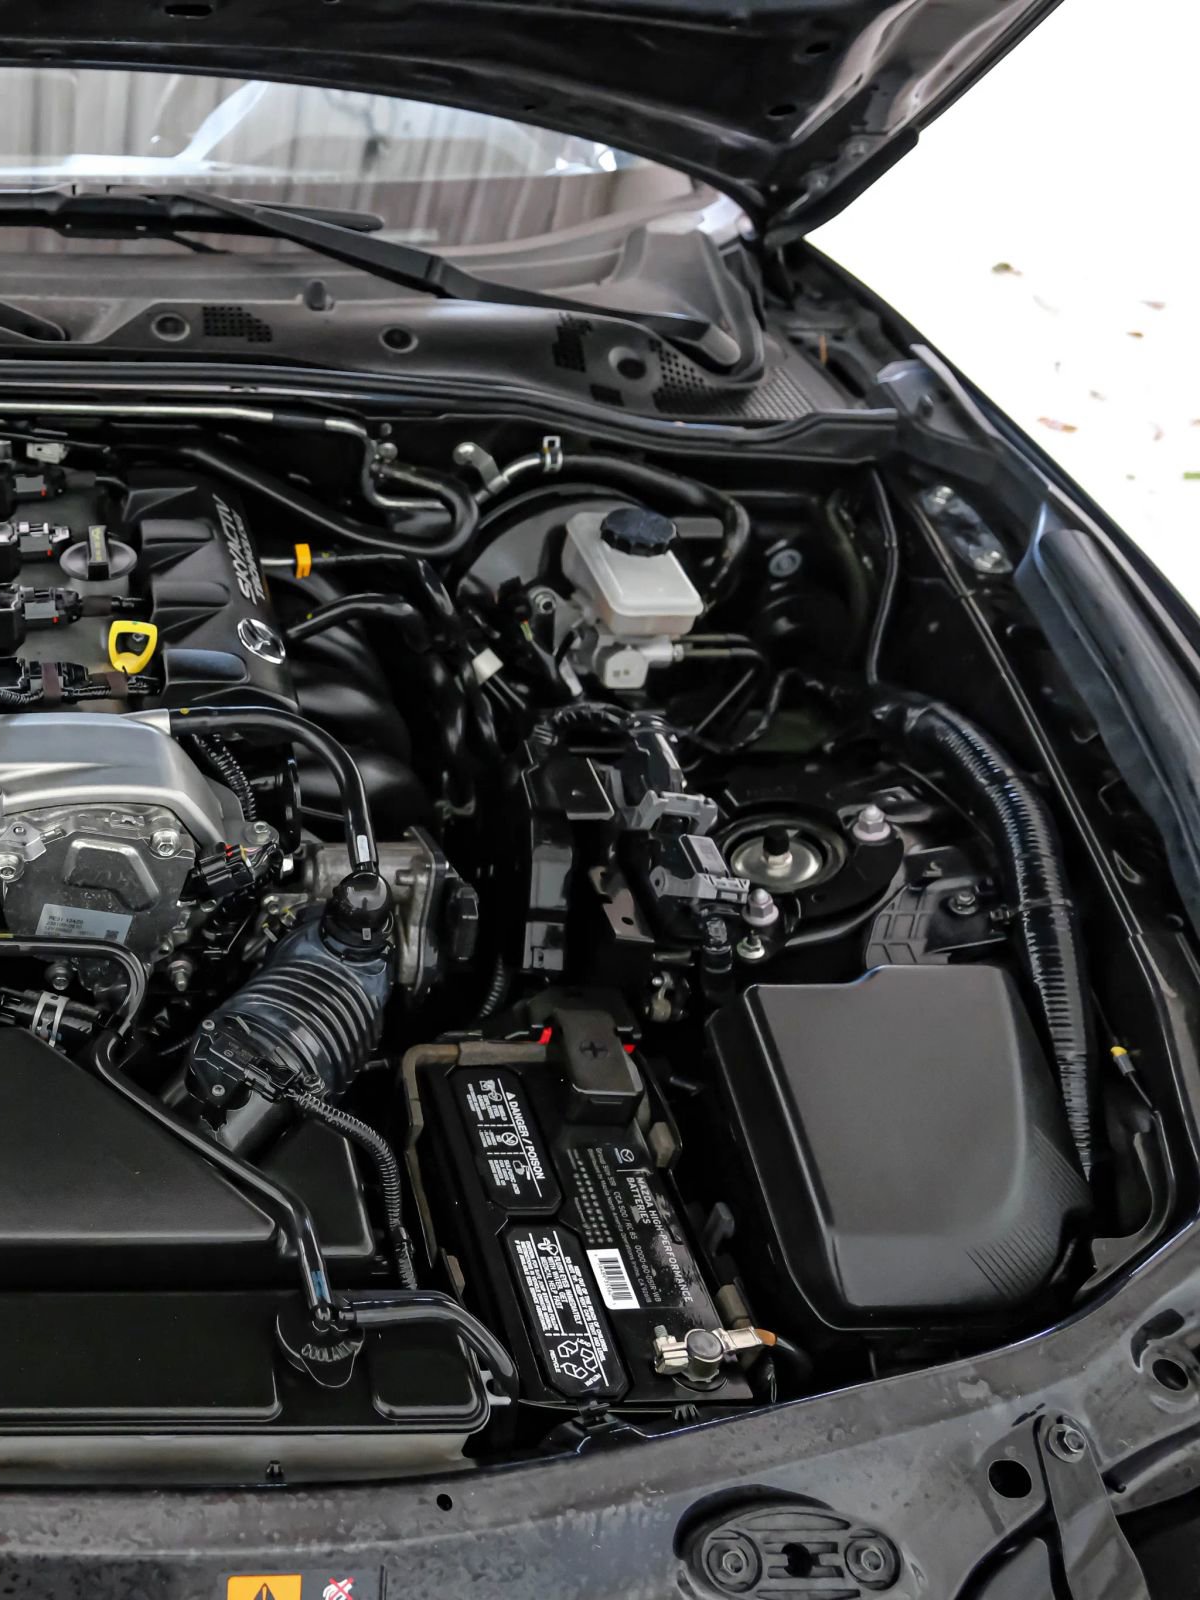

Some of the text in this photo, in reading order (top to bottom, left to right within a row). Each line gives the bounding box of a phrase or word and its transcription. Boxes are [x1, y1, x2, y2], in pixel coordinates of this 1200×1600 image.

[509, 1101, 529, 1136] DANGER
[525, 1145, 545, 1179] POISON
[612, 1191, 623, 1203] CCA
[617, 1205, 628, 1217] 500
[625, 1177, 651, 1224] BATTERIES
[635, 1177, 693, 1302] MAZDA HIGH-PERFORMANCE
[539, 1256, 563, 1309] MEDICAL HELP FAST
[546, 1256, 556, 1269] WITH
[558, 1291, 568, 1302] GET
[553, 1256, 582, 1324] FLUSH EYES IMMEDIATELY
[548, 1349, 561, 1372] RECYCLE
